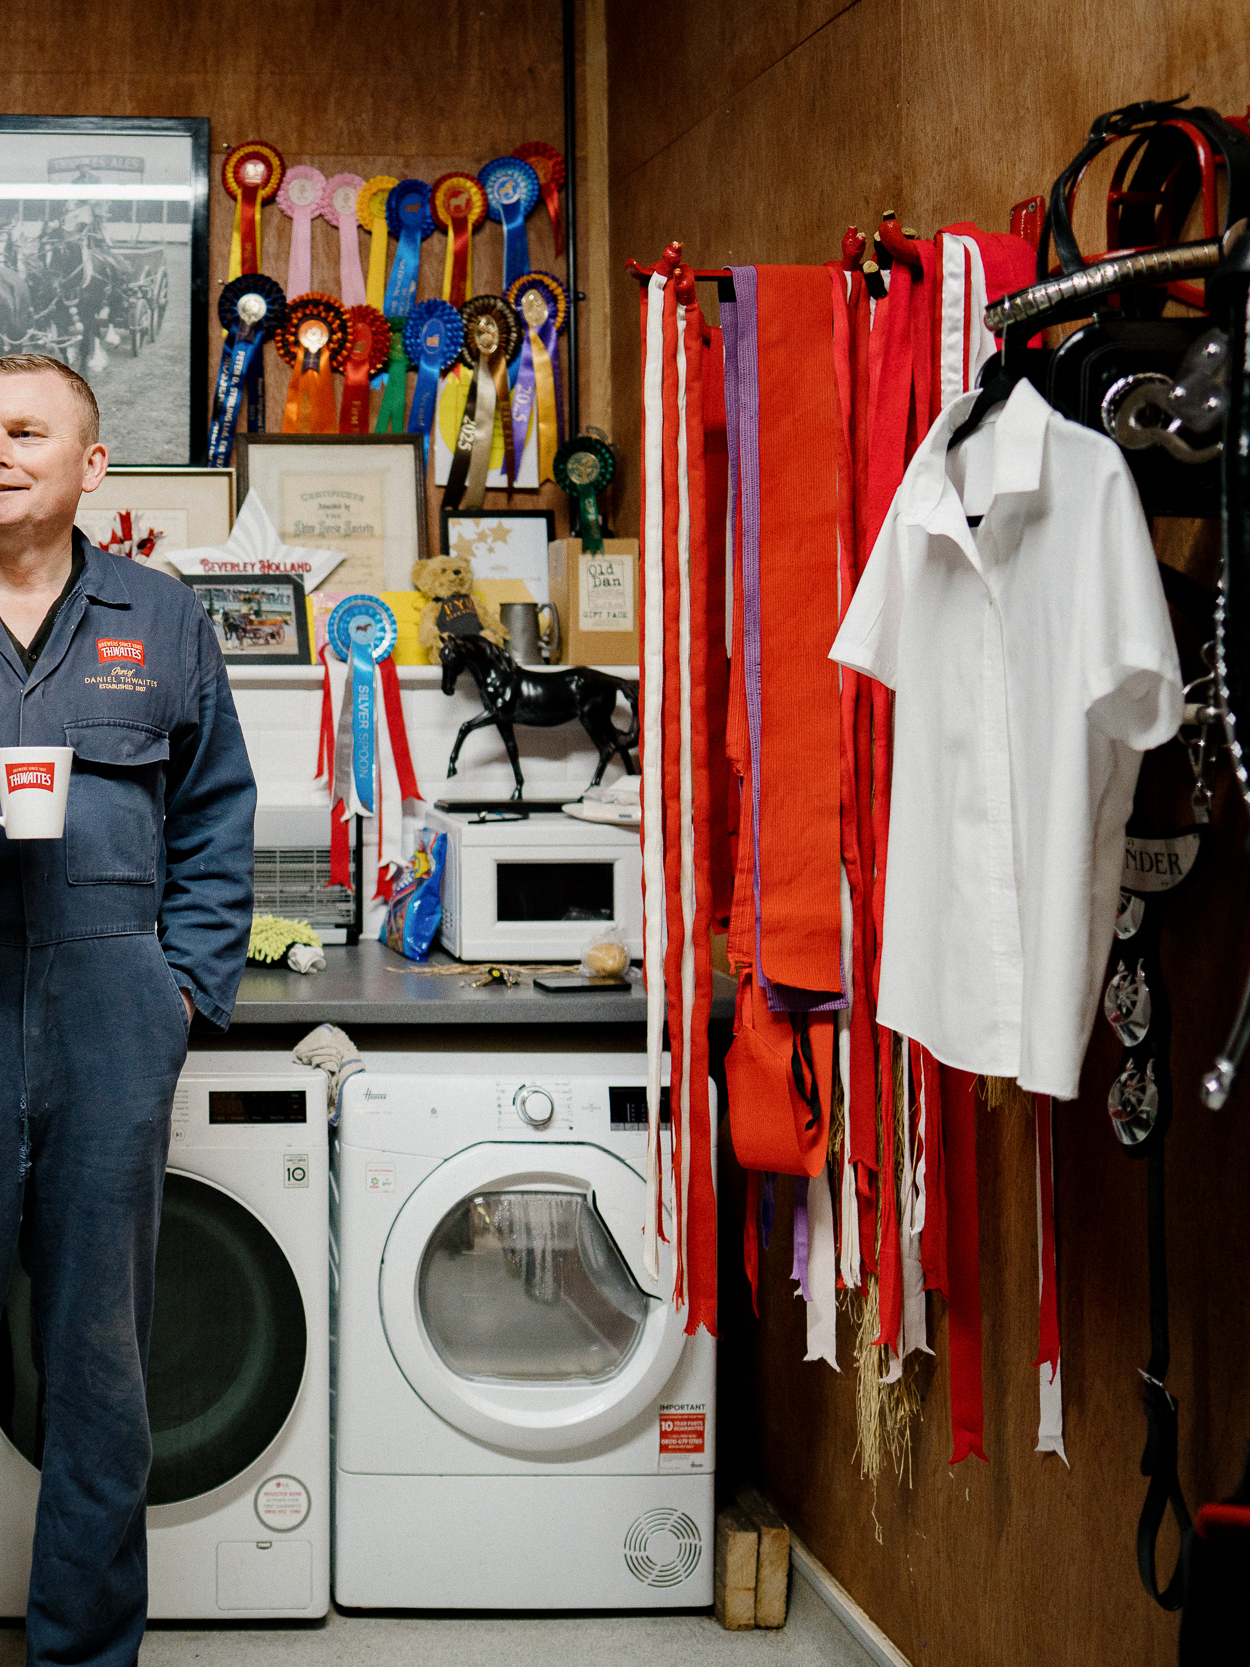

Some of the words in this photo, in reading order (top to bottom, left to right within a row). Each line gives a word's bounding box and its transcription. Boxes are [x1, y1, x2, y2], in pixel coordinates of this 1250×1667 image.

[224, 387, 239, 422] STIRLING
[512, 383, 532, 422] 2025
[457, 415, 476, 452] 2025
[588, 563, 614, 577] Old
[592, 577, 622, 588] Dan
[101, 646, 142, 660] THWAITES
[127, 668, 136, 677] of
[84, 676, 117, 684] DANIEL
[119, 676, 158, 688] THWAITES
[99, 683, 133, 691] ESTABLISHED
[358, 685, 370, 729] SILVER
[358, 732, 370, 778] SPOON
[9, 771, 51, 787] THWAITES
[660, 1403, 706, 1411] IMPORTANT
[661, 1421, 674, 1432] 10
